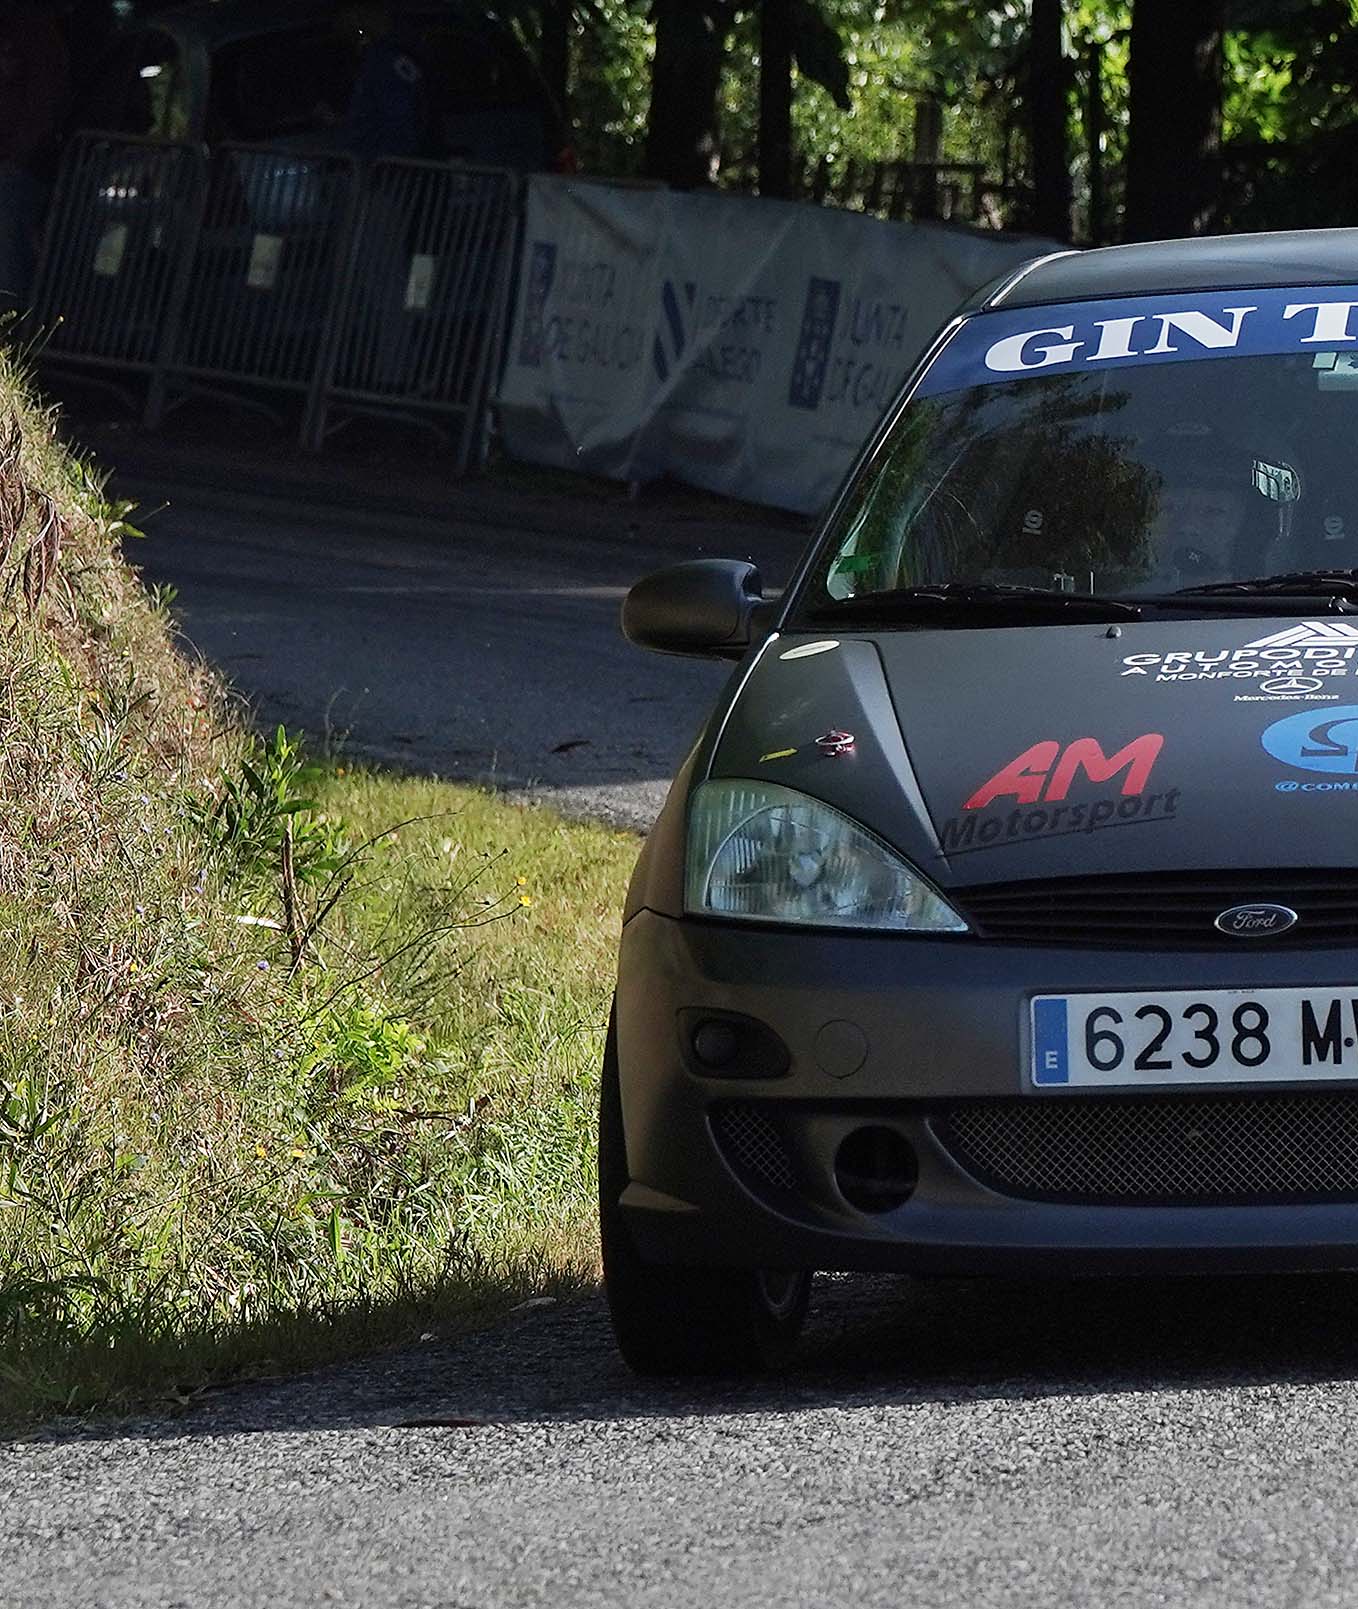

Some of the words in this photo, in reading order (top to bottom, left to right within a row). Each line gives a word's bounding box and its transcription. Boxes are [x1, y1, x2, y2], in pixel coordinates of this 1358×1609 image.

[983, 305, 1259, 373] GIN
[1155, 669, 1302, 682] MONFORTE
[1311, 668, 1348, 677] DE
[961, 732, 1165, 810] AM
[941, 787, 1182, 849] Motorsport
[1232, 910, 1277, 929] Ford
[1045, 1050, 1059, 1070] E
[1085, 1001, 1272, 1072] 6238
